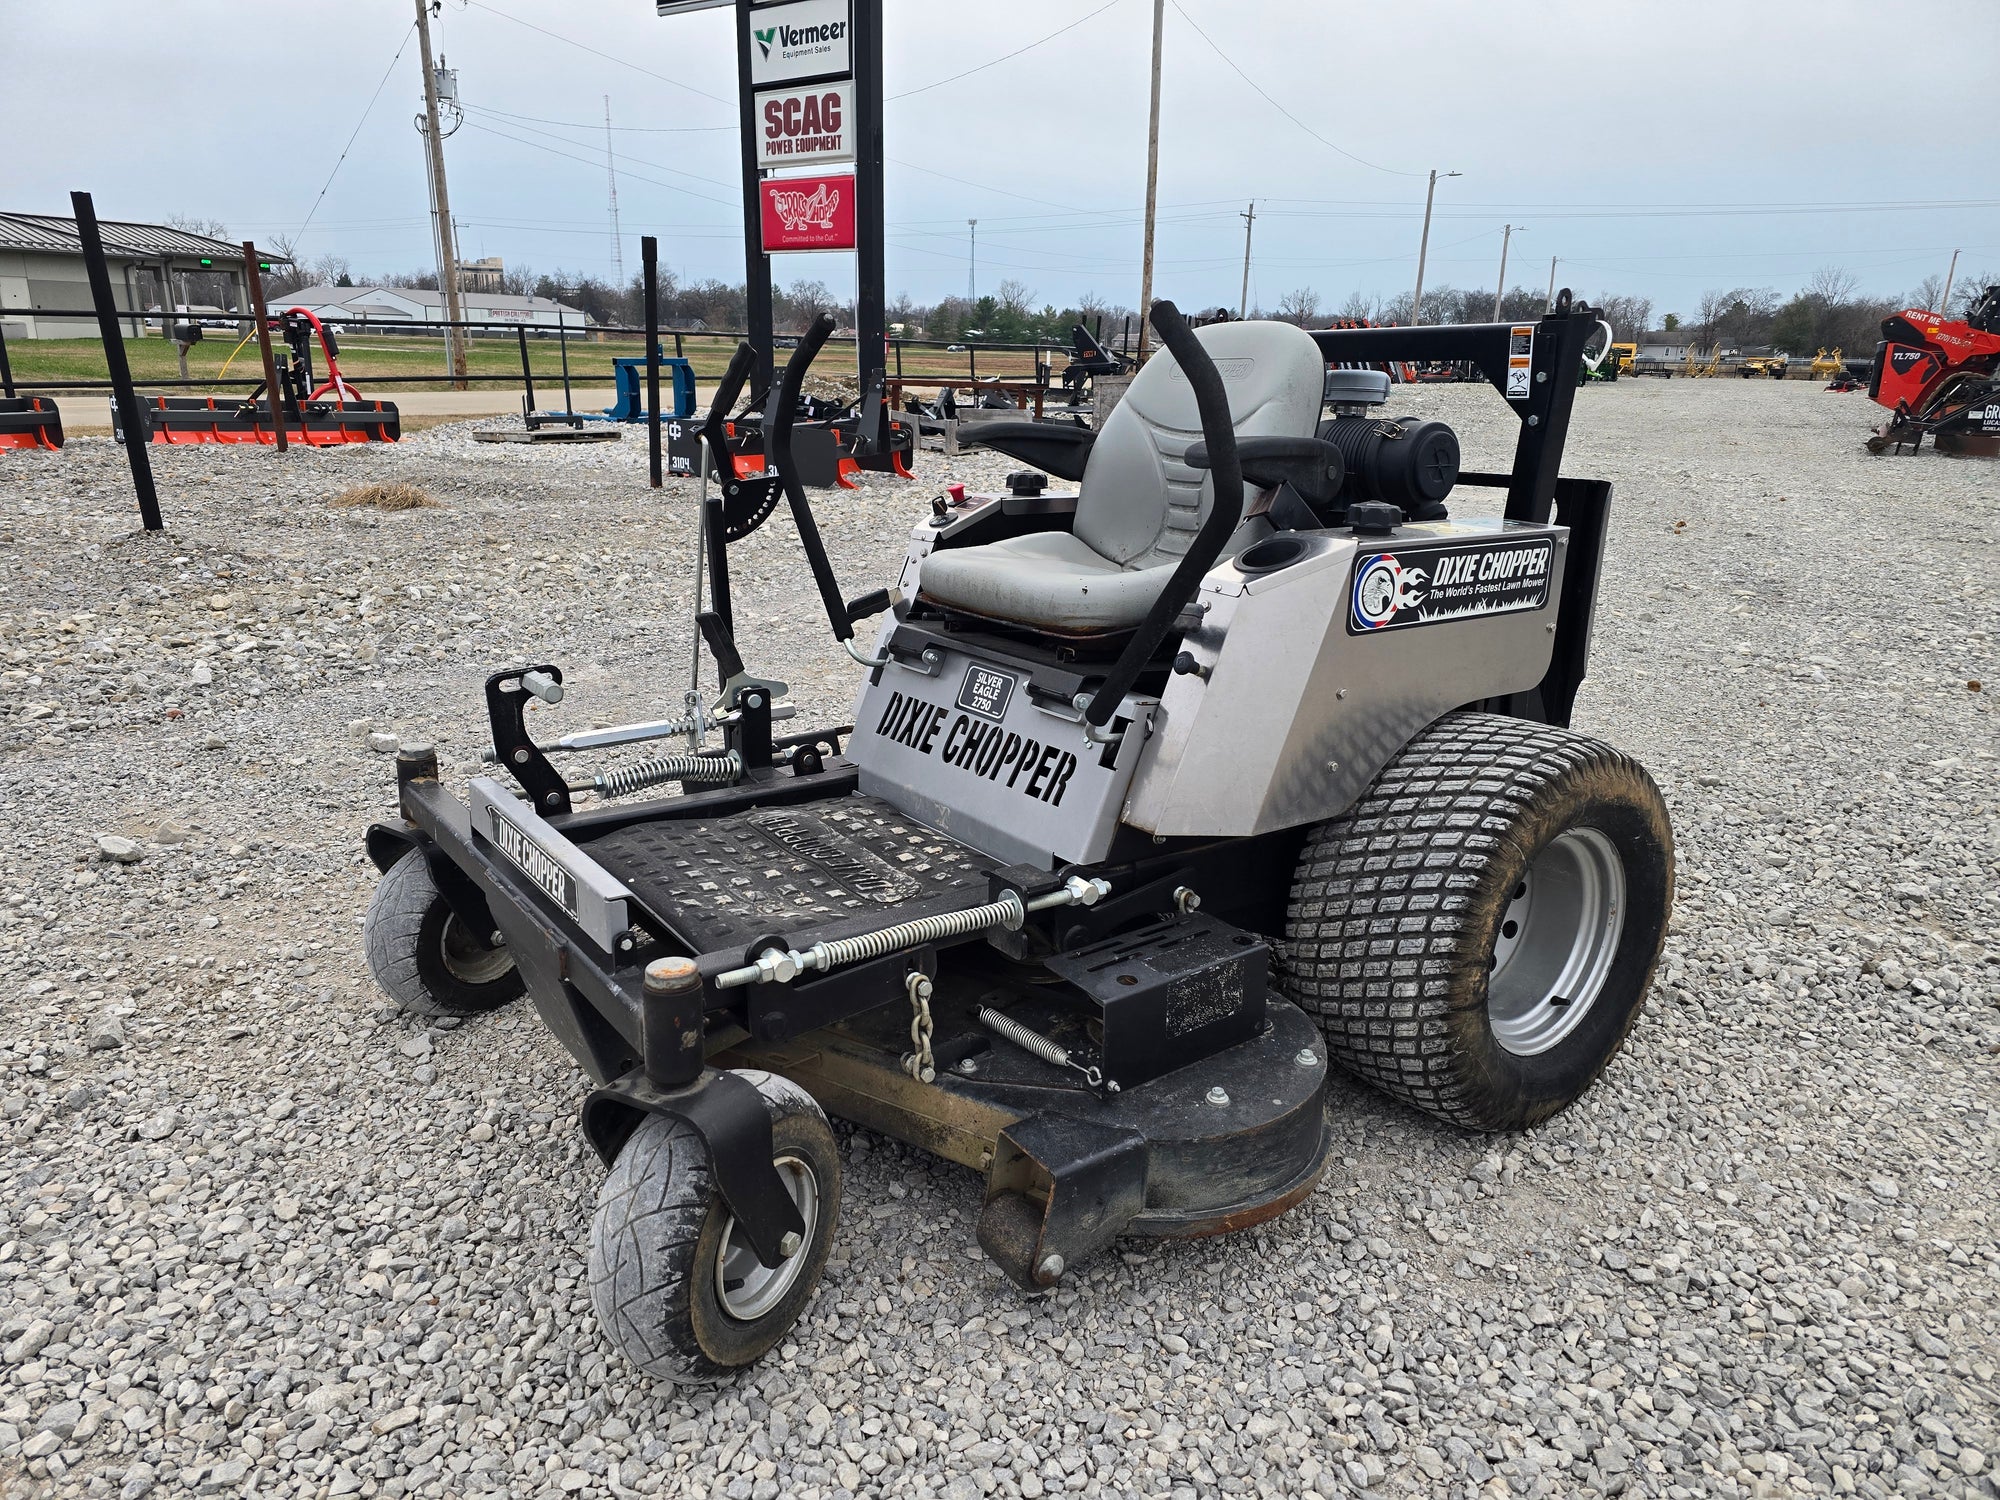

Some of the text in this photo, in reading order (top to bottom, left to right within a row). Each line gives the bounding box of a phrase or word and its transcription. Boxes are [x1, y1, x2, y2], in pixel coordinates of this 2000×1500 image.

[779, 21, 846, 47] Vermeer
[782, 45, 831, 59] Equipment Sales
[764, 92, 842, 138] SCAG
[766, 135, 842, 156] POWER EQUIPMENT
[782, 234, 809, 243] Committed
[1905, 310, 1942, 325] RENT ME
[672, 456, 690, 469] 3104
[1431, 547, 1549, 586] DIXIE CHOPPER
[1429, 578, 1545, 600] The World's Fastest Lawn Mower
[976, 671, 1003, 689] SILVER
[972, 682, 1001, 701] EAGLE
[971, 696, 992, 711] 2750
[876, 691, 1077, 808] DIXIE CHOPPER
[499, 817, 566, 905] DIXIE CHOPPER
